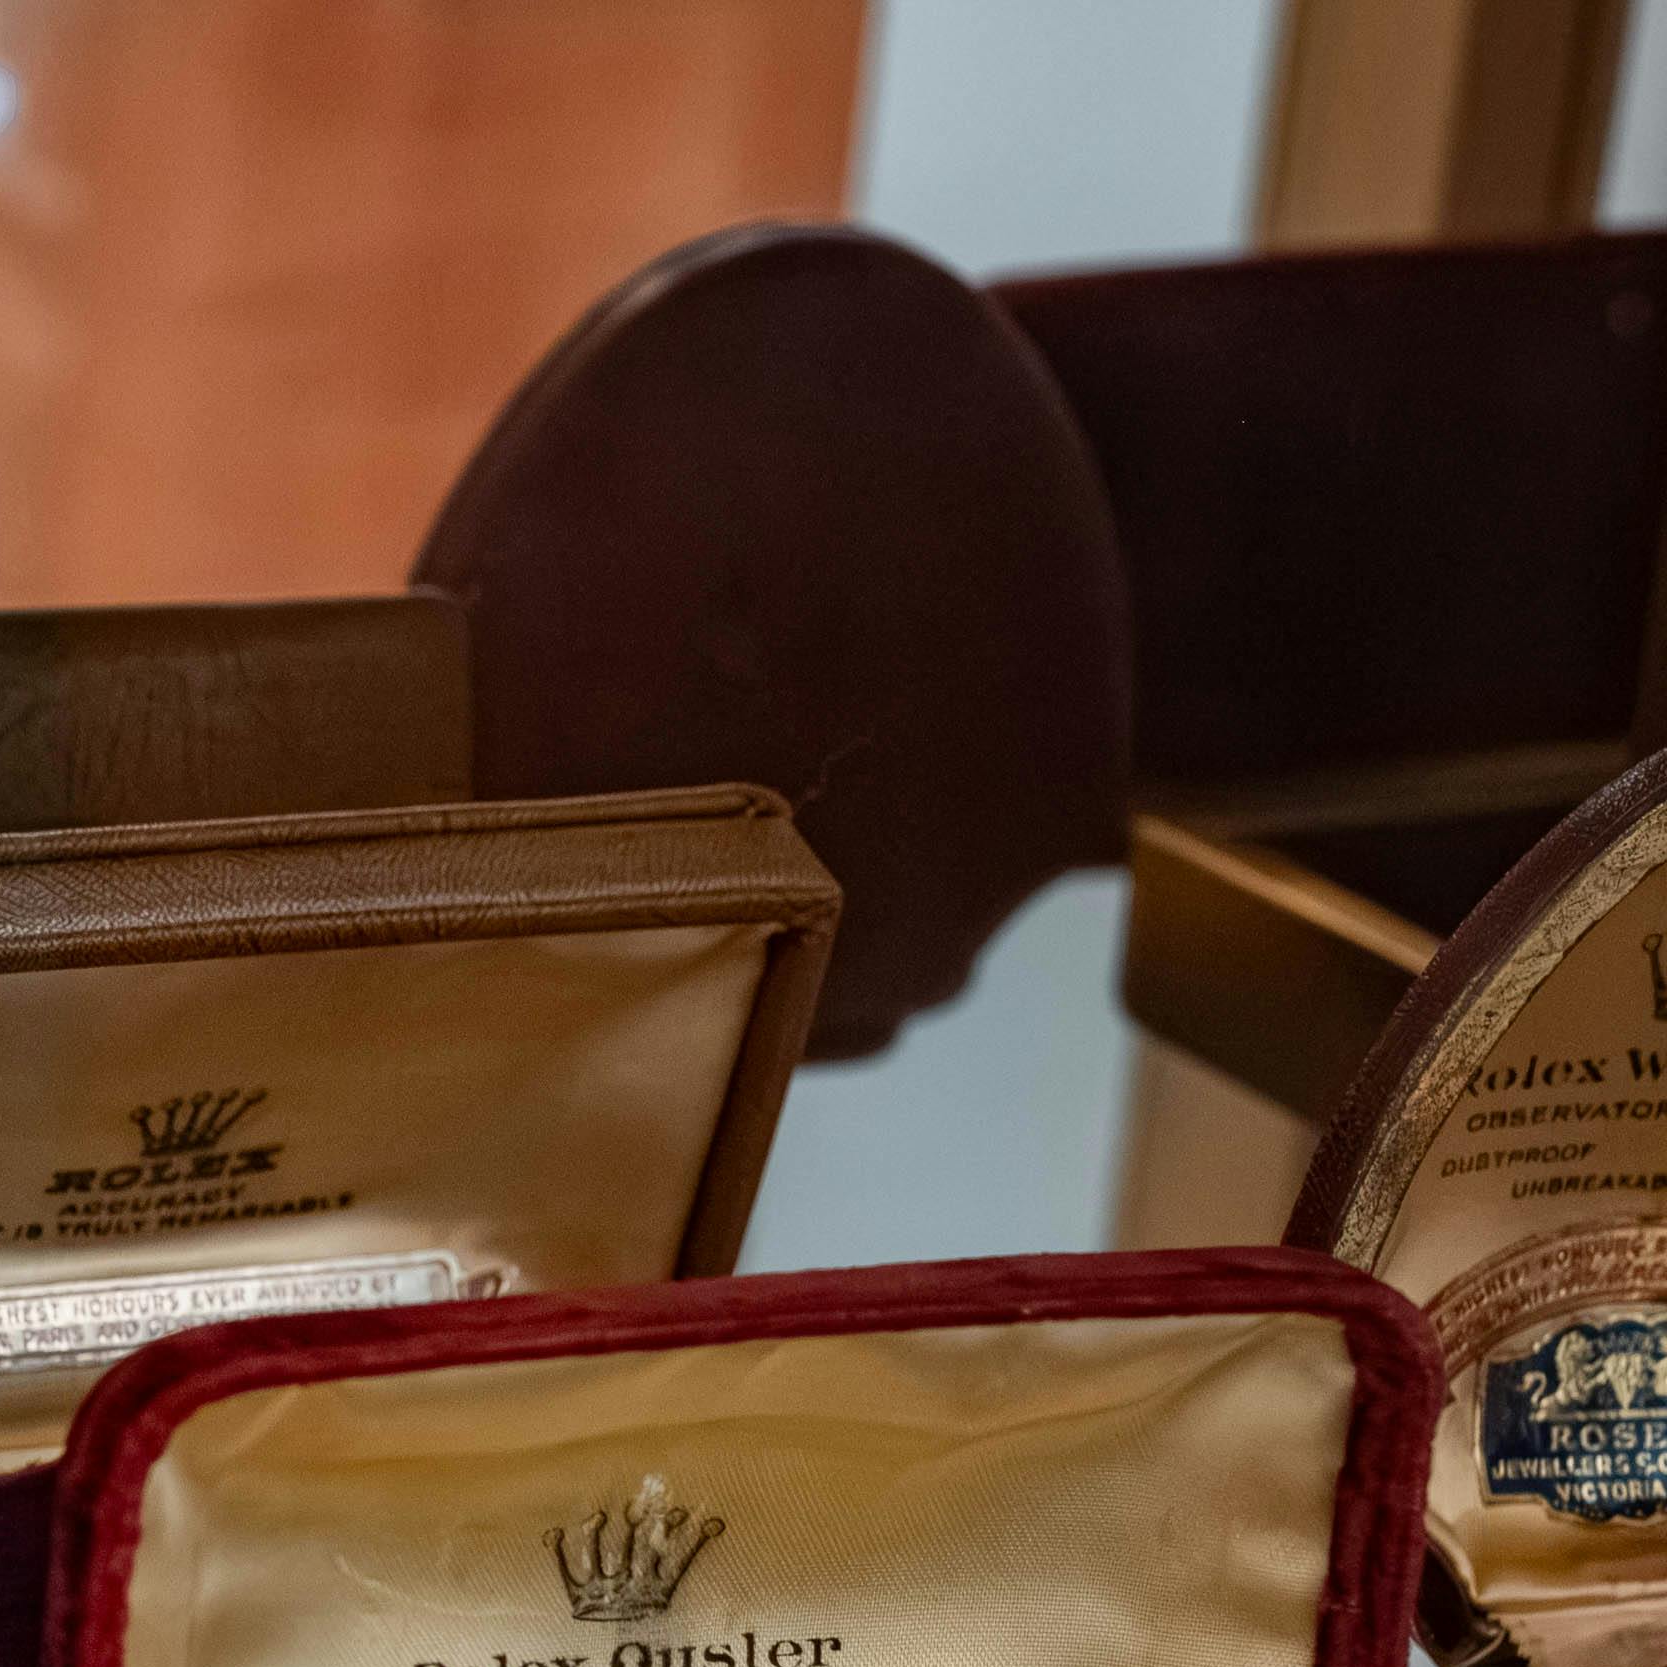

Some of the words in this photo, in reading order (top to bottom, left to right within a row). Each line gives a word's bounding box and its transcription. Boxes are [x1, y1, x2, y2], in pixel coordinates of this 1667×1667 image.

[46, 1143, 284, 1194] ROLEX
[1440, 1142, 1598, 1179] DUSTPROOF
[56, 1218, 145, 1239] TRULY
